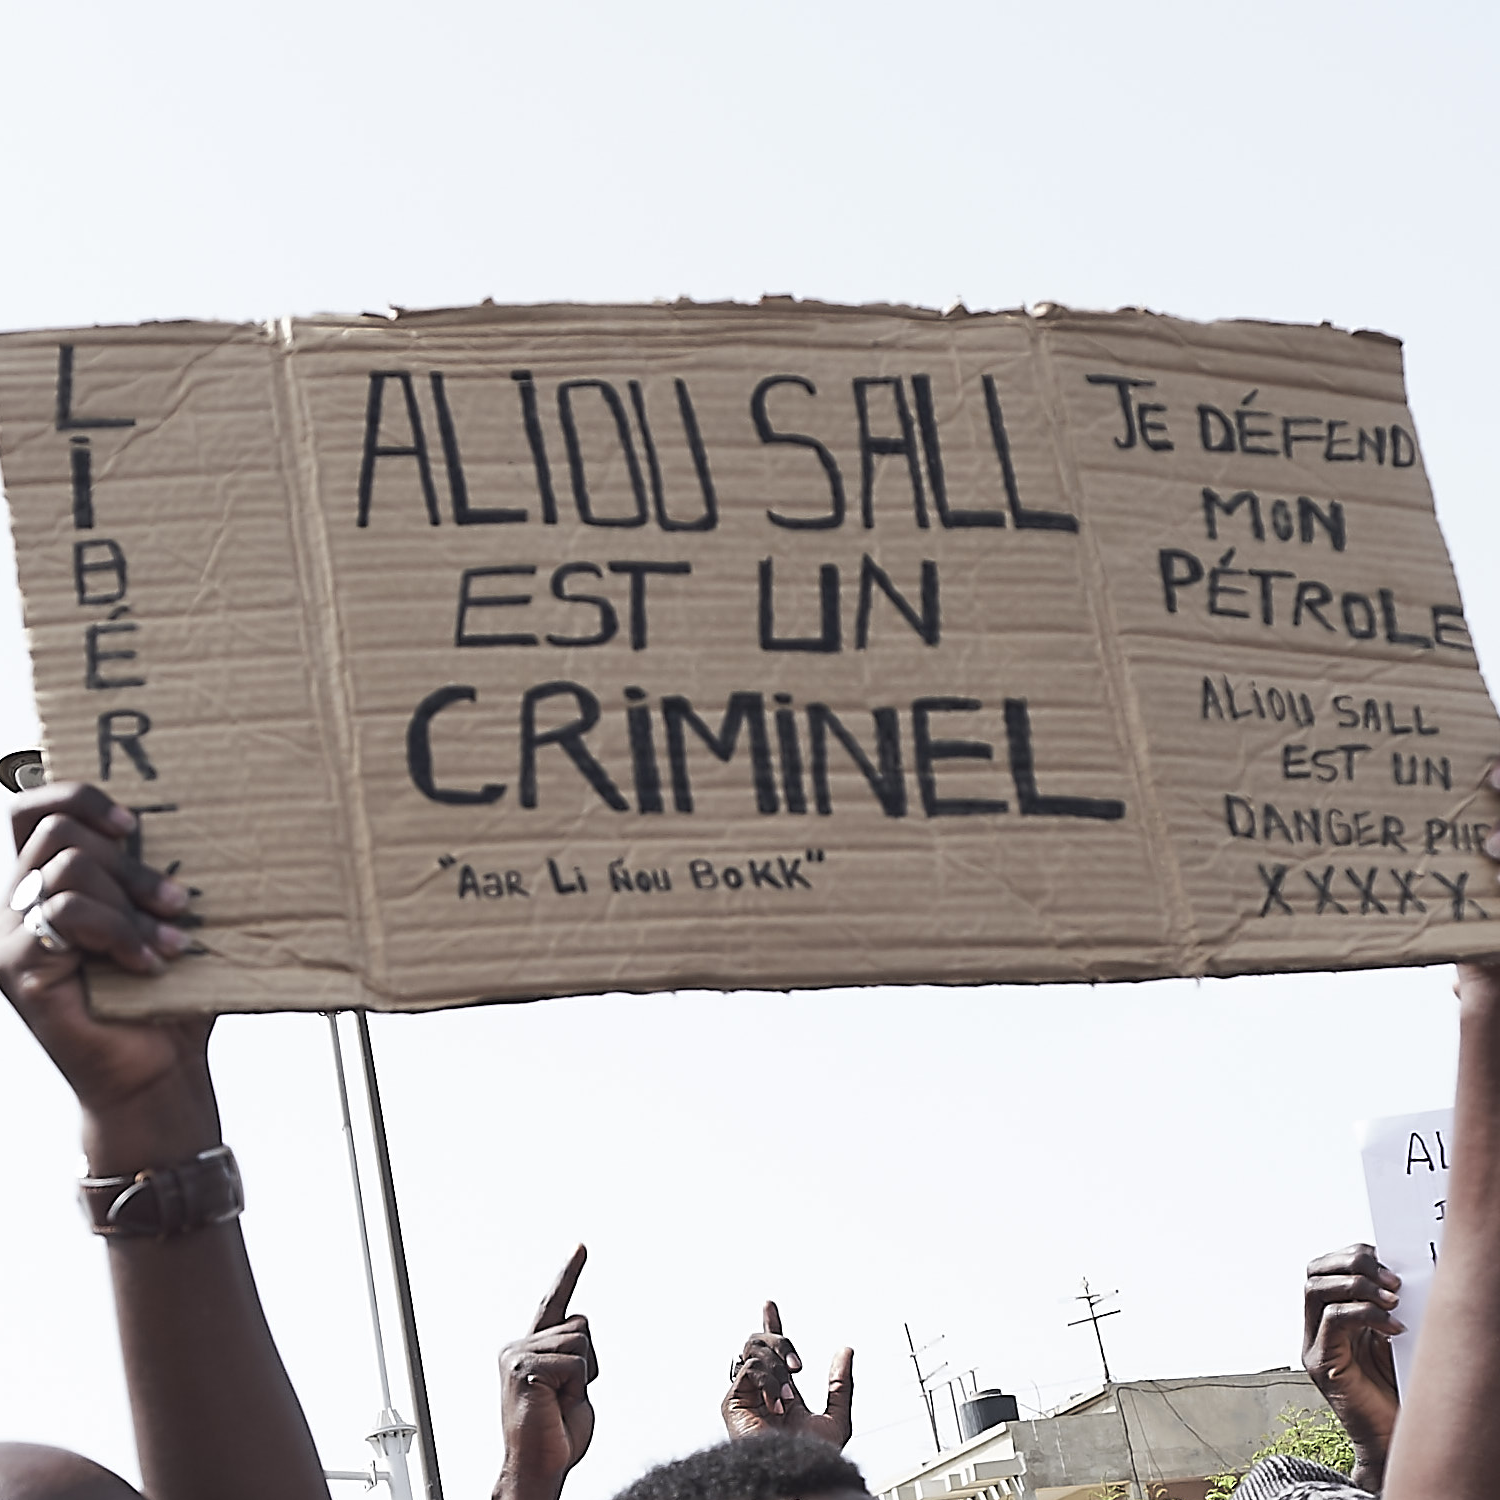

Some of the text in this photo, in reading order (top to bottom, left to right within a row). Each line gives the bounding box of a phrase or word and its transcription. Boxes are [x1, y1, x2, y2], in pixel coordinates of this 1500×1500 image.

[749, 373, 1081, 534] SALL
[1196, 388, 1417, 468] DÉFEND
[1201, 486, 1347, 552] MON
[454, 553, 942, 653] EST UN
[1158, 546, 1477, 653] PÉTROLE
[1332, 694, 1440, 736] SALL
[1282, 743, 1453, 792] EST UN
[1224, 793, 1409, 853] DANGER
